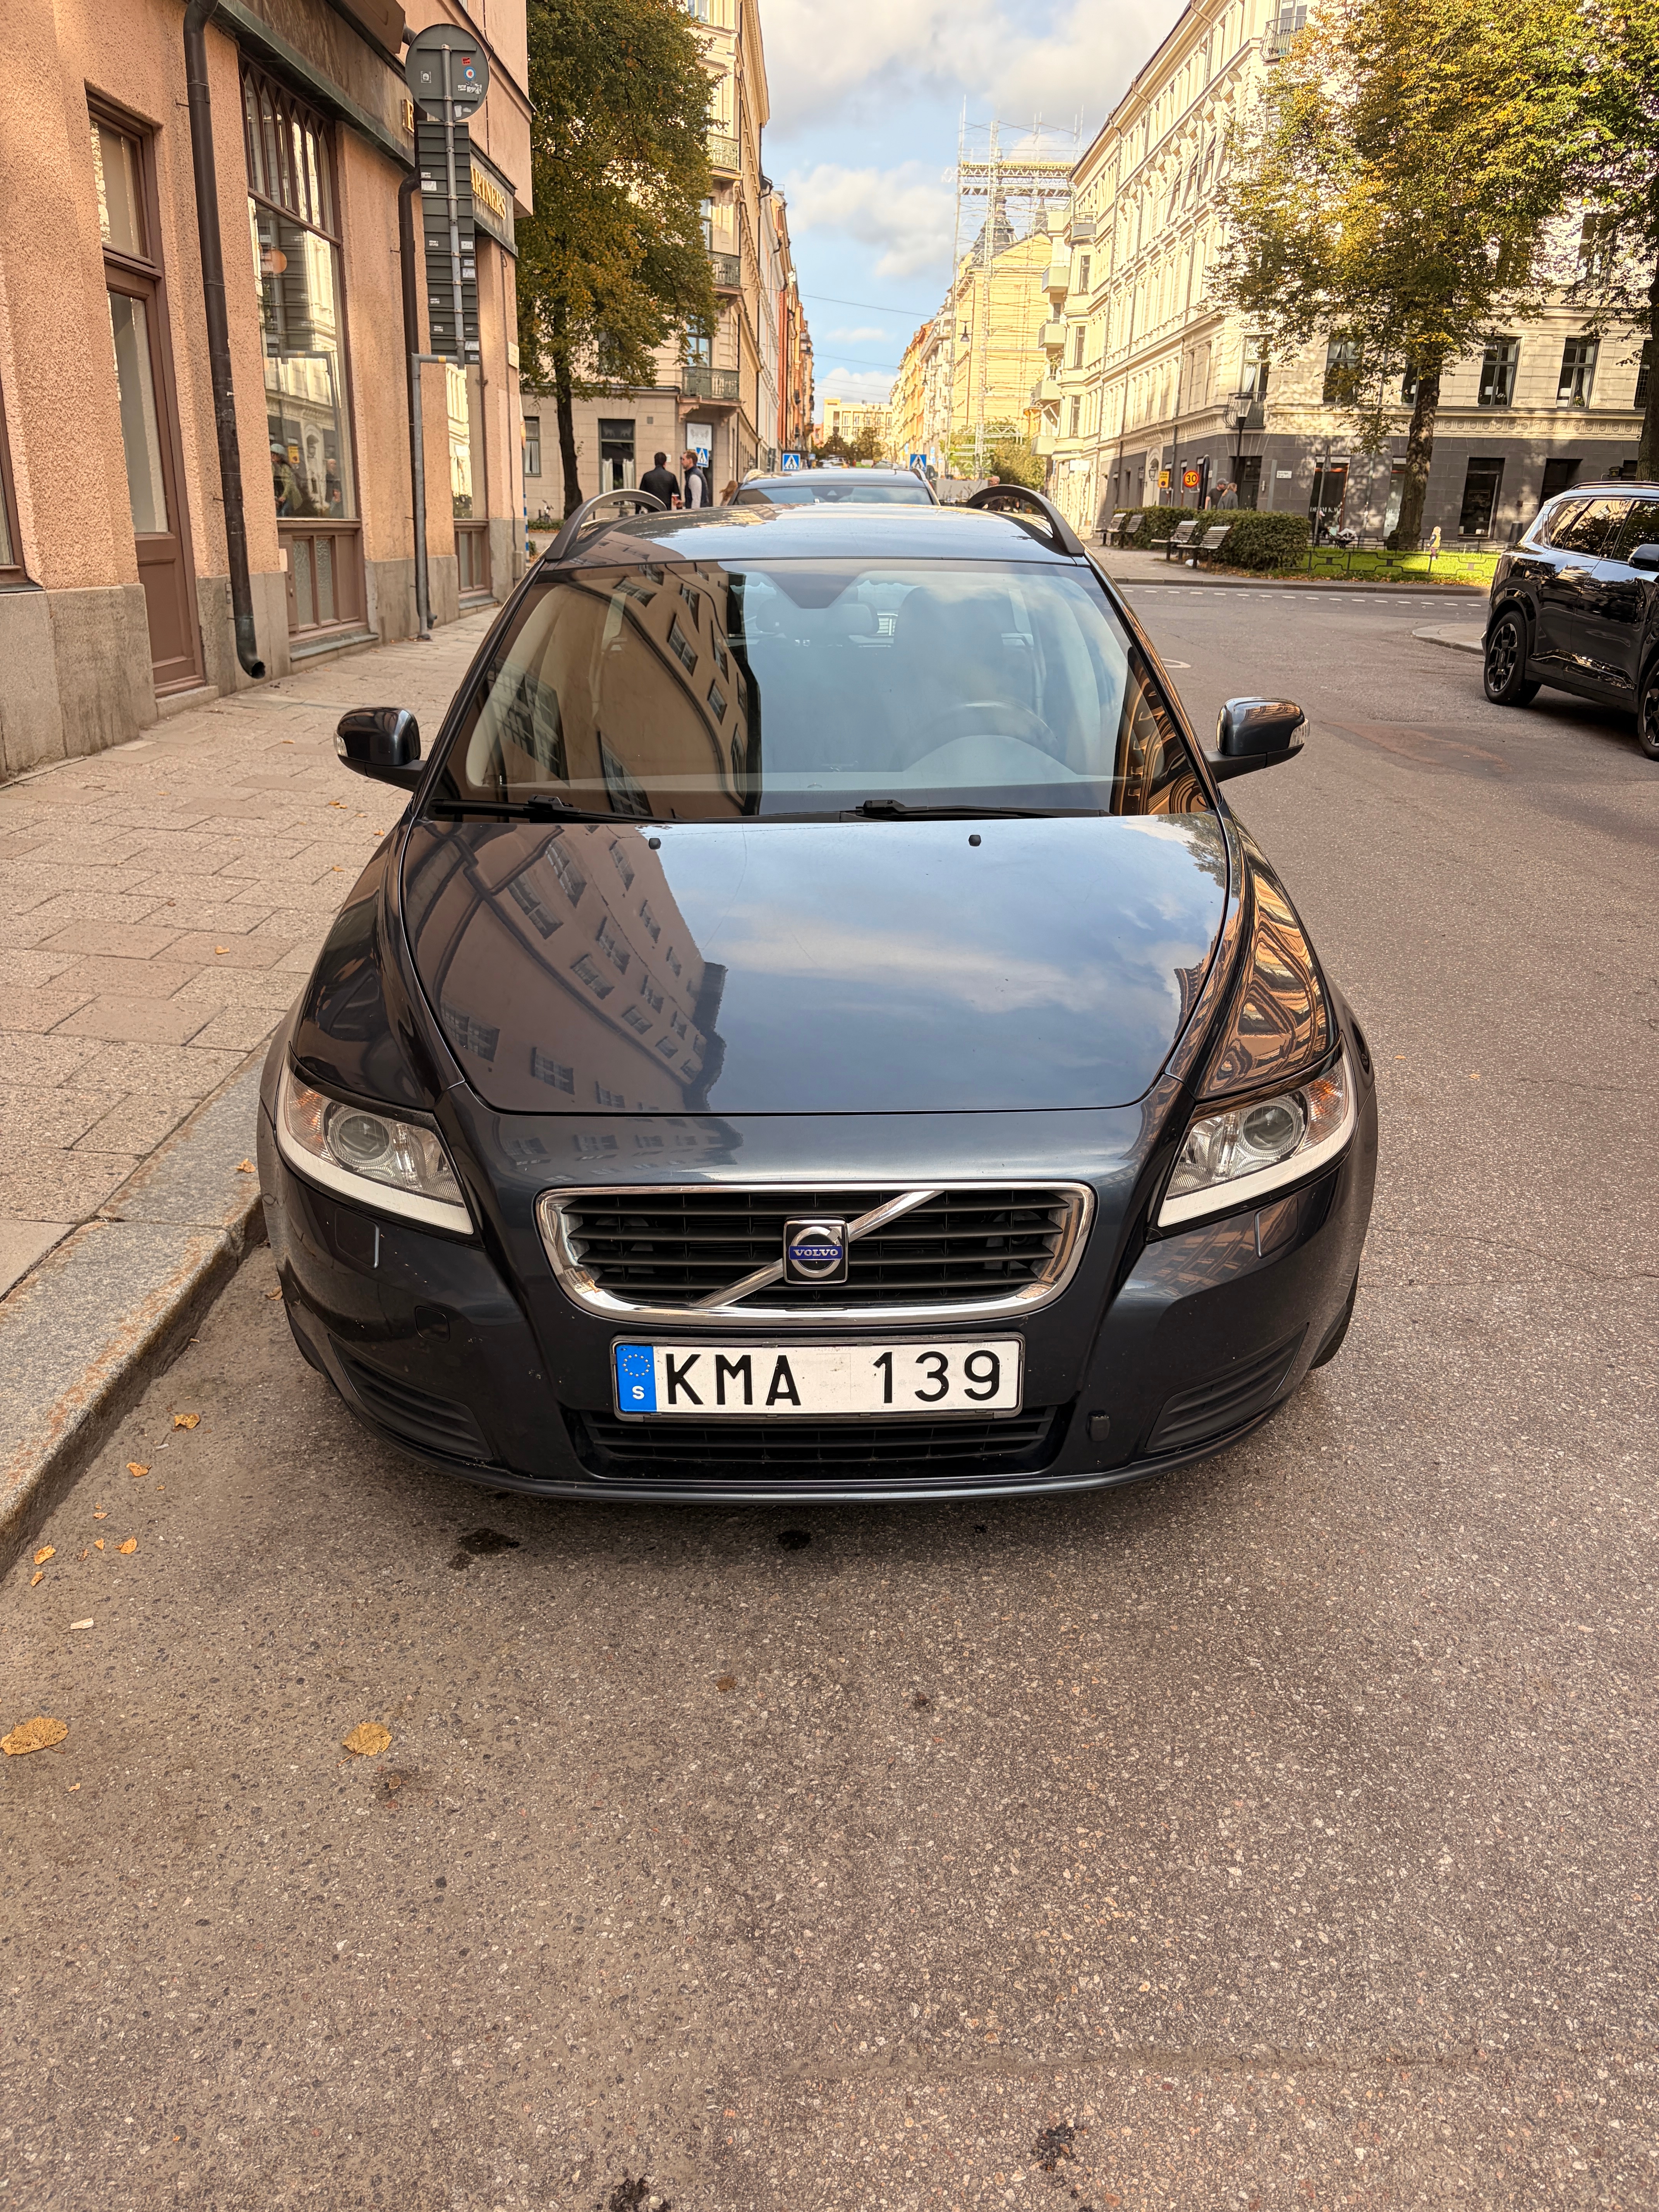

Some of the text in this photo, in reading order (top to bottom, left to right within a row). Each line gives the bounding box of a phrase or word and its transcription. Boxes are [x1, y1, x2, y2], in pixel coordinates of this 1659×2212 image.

[470, 163, 507, 220] ARTNERS
[1186, 474, 1197, 483] 30
[632, 1386, 645, 1400] S
[665, 1350, 1000, 1406] KMA 139
